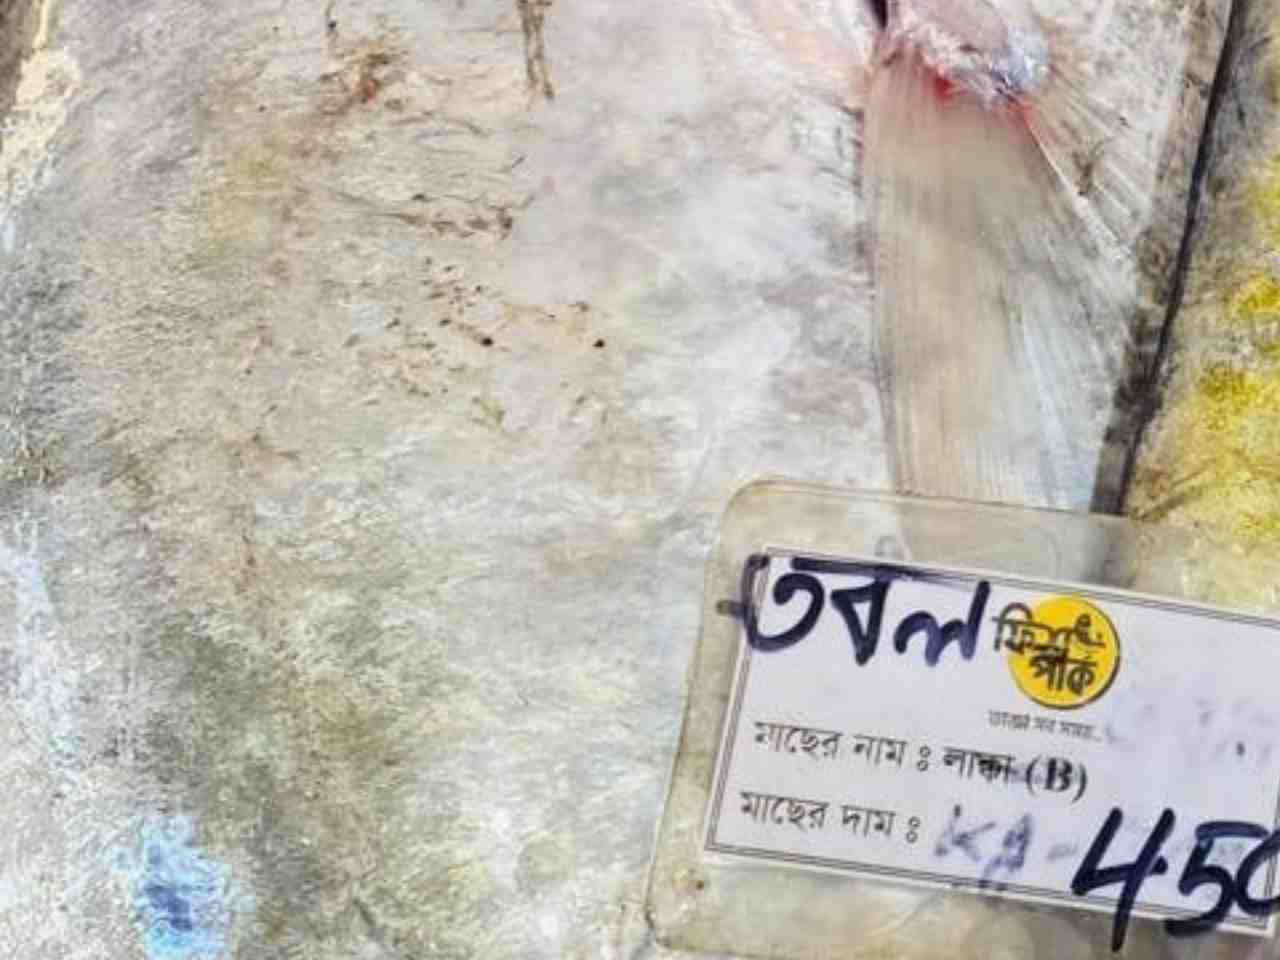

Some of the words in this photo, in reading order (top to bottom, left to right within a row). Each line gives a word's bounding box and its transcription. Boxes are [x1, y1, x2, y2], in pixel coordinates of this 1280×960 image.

[754, 720, 843, 759] মাছের
[853, 734, 908, 767] নাম
[1025, 754, 1088, 803] (B)
[739, 791, 830, 829] মাছের
[840, 804, 897, 837] দাম
